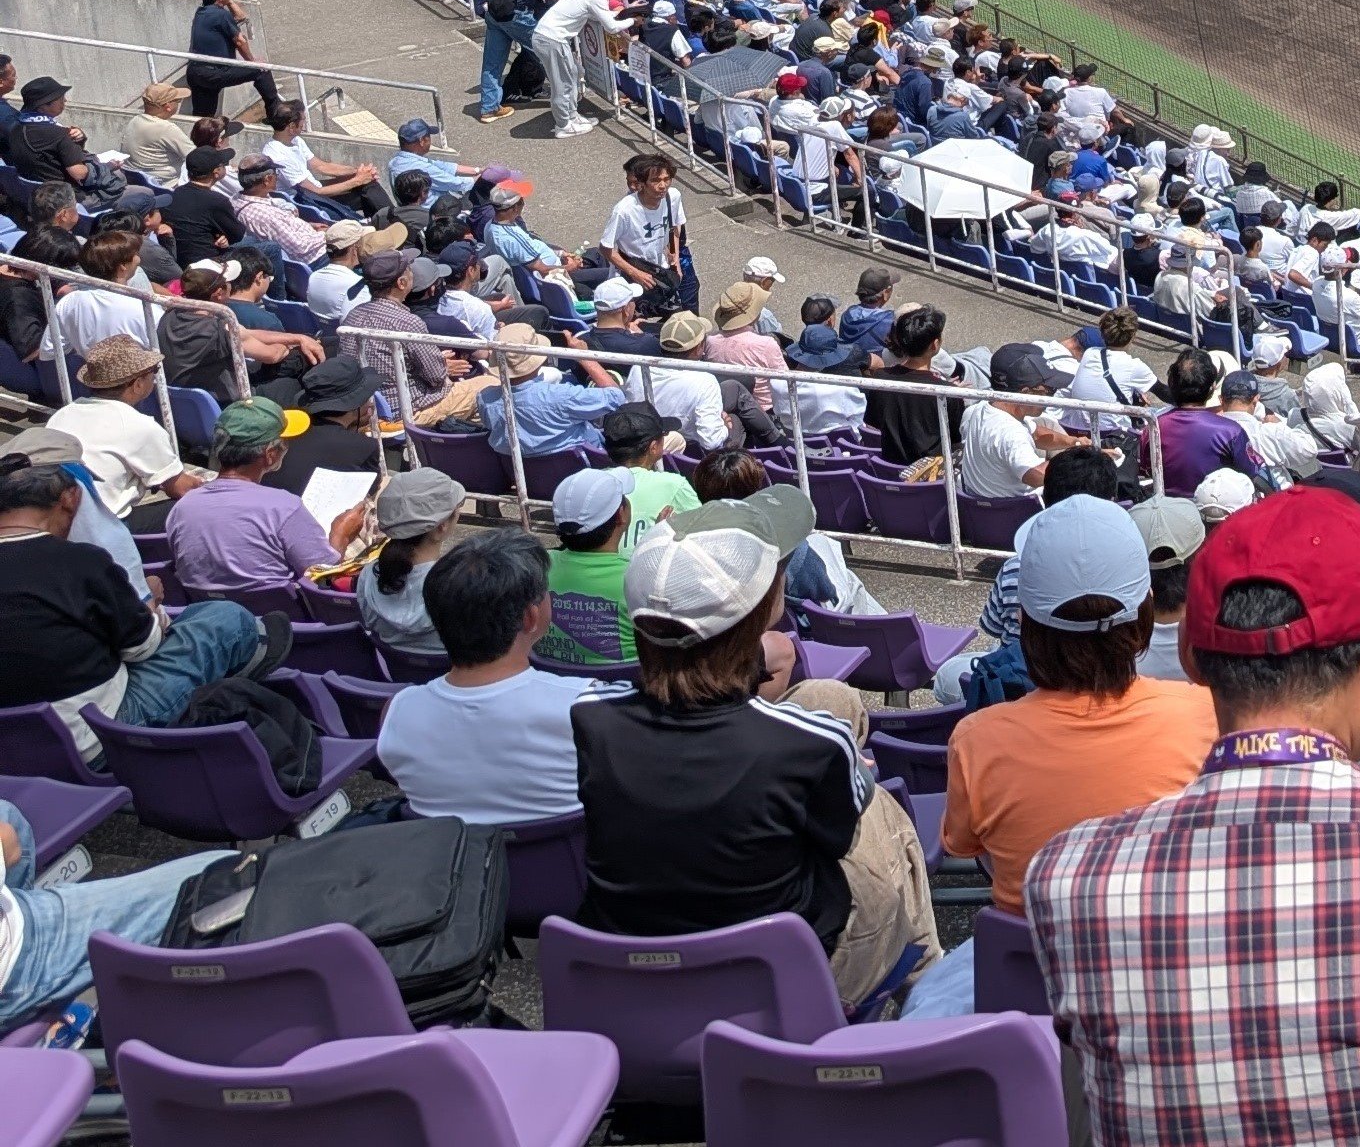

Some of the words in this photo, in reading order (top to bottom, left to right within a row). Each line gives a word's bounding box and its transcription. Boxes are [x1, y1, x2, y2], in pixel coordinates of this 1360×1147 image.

[1234, 732, 1281, 759] MIKE
[1286, 734, 1320, 759] THE
[633, 954, 676, 963] F-21-13
[823, 1068, 876, 1078] F-22-14
